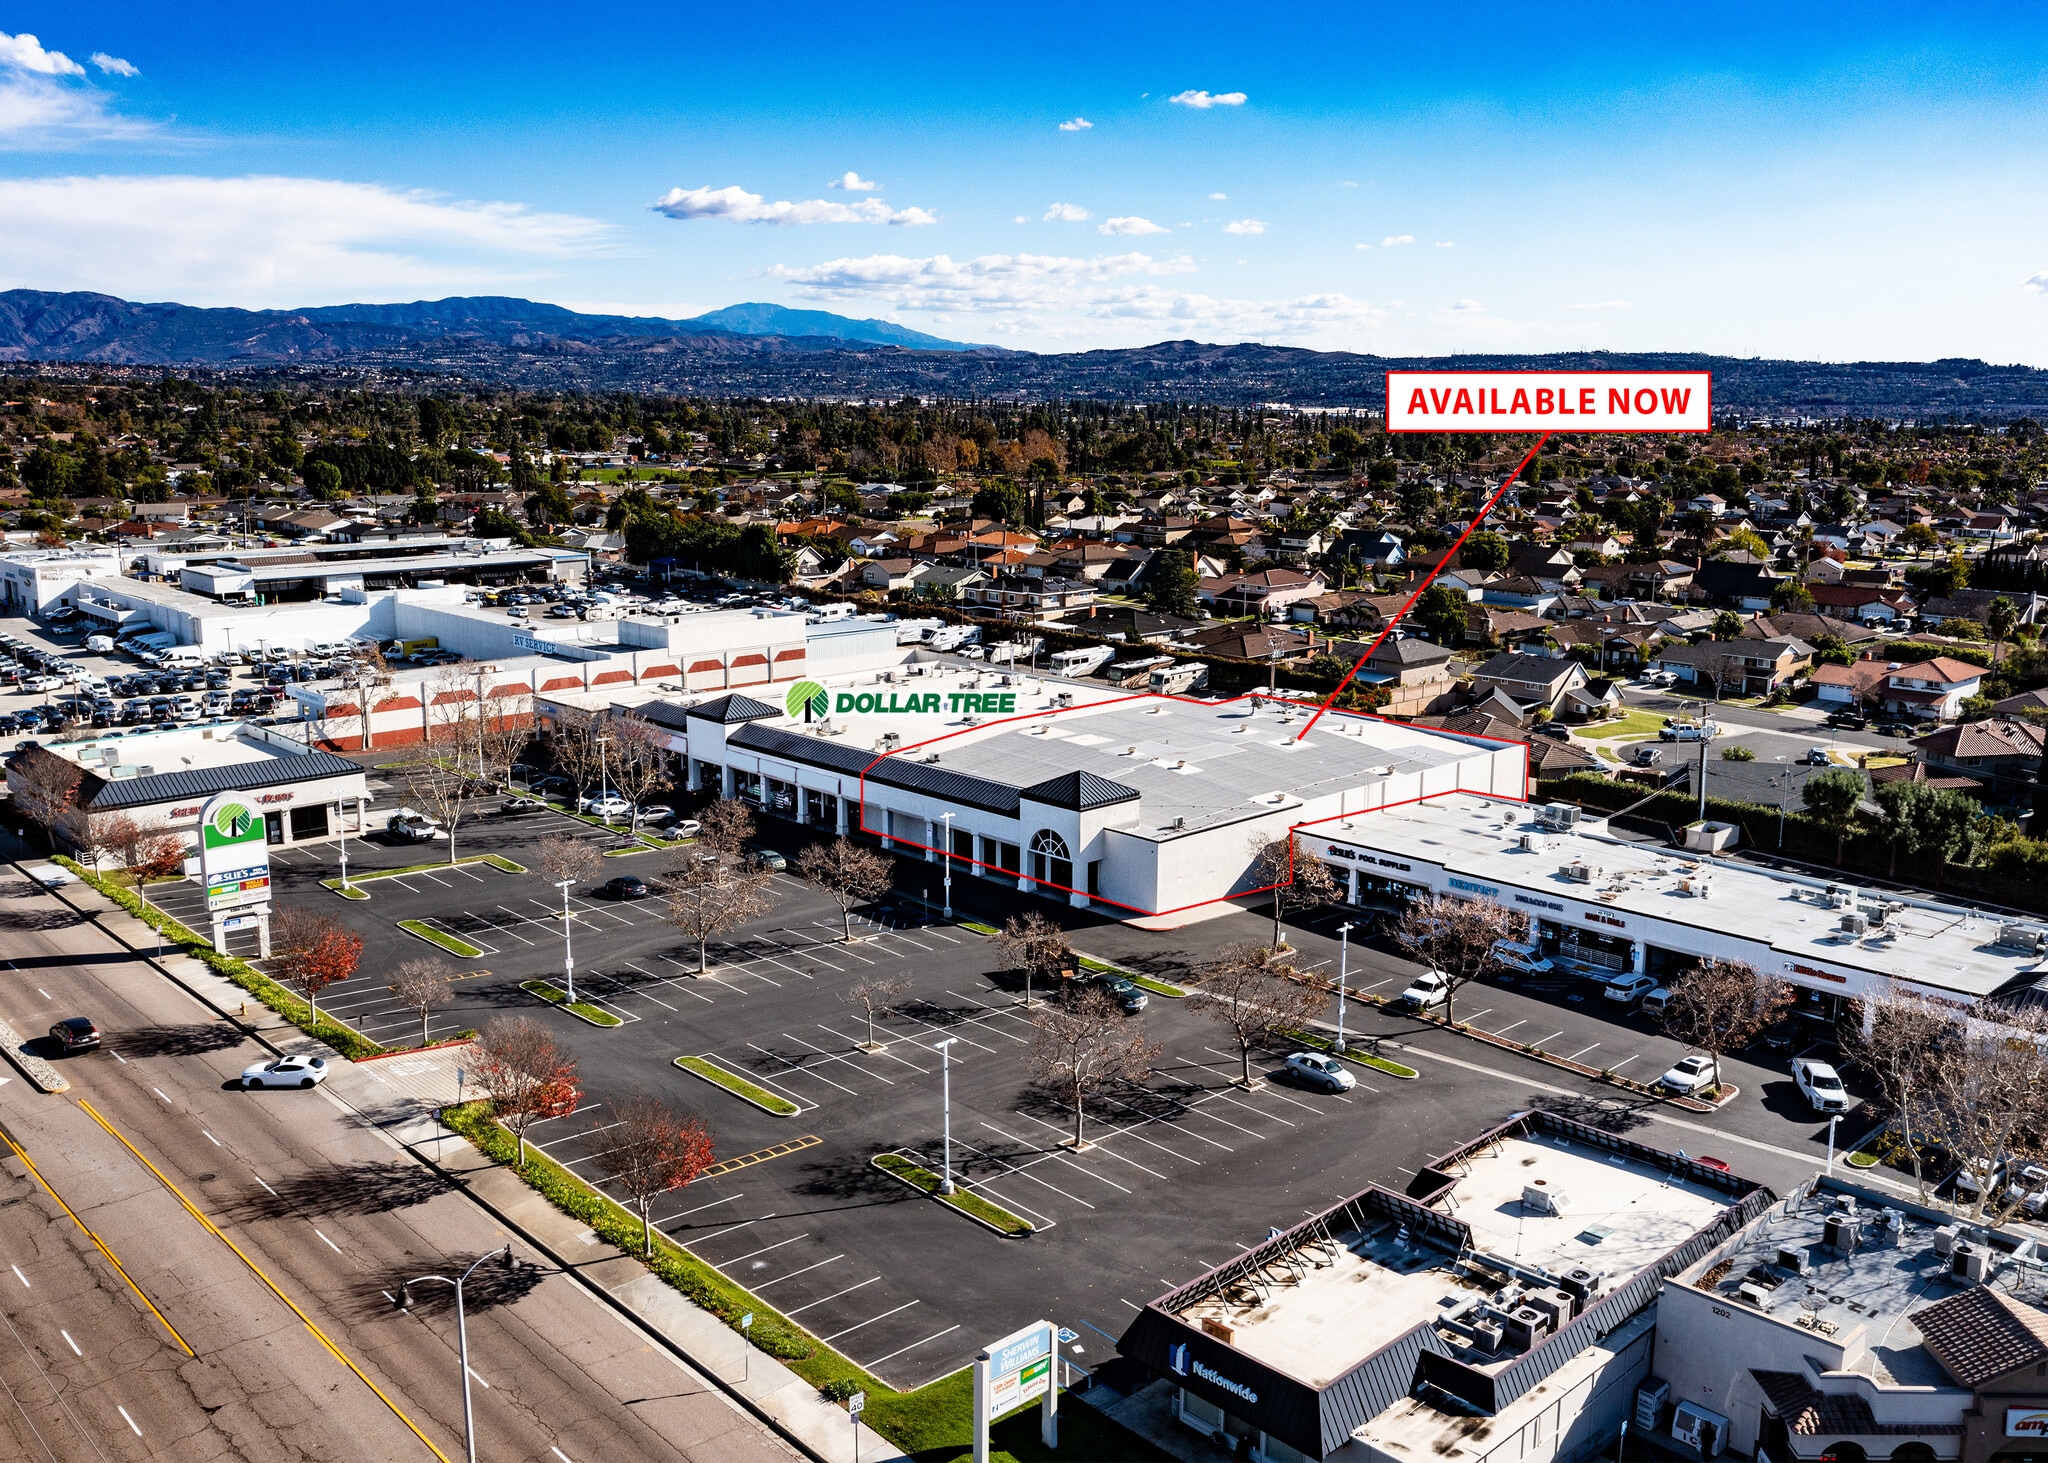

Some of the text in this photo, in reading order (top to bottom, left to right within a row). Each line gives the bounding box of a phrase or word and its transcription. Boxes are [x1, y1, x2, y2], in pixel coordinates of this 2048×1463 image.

[514, 635, 556, 653] RV SERVICE
[1358, 854, 1377, 865] POOL
[1379, 859, 1411, 872] SUPPLIES
[1449, 878, 1499, 897] DENTIST
[1712, 1306, 1731, 1319] 1202
[1002, 1335, 1040, 1360] SHERWIN
[1001, 1346, 1039, 1372] WILLIAMS
[1193, 1361, 1258, 1403] Nationwide
[851, 1402, 863, 1411] 40
